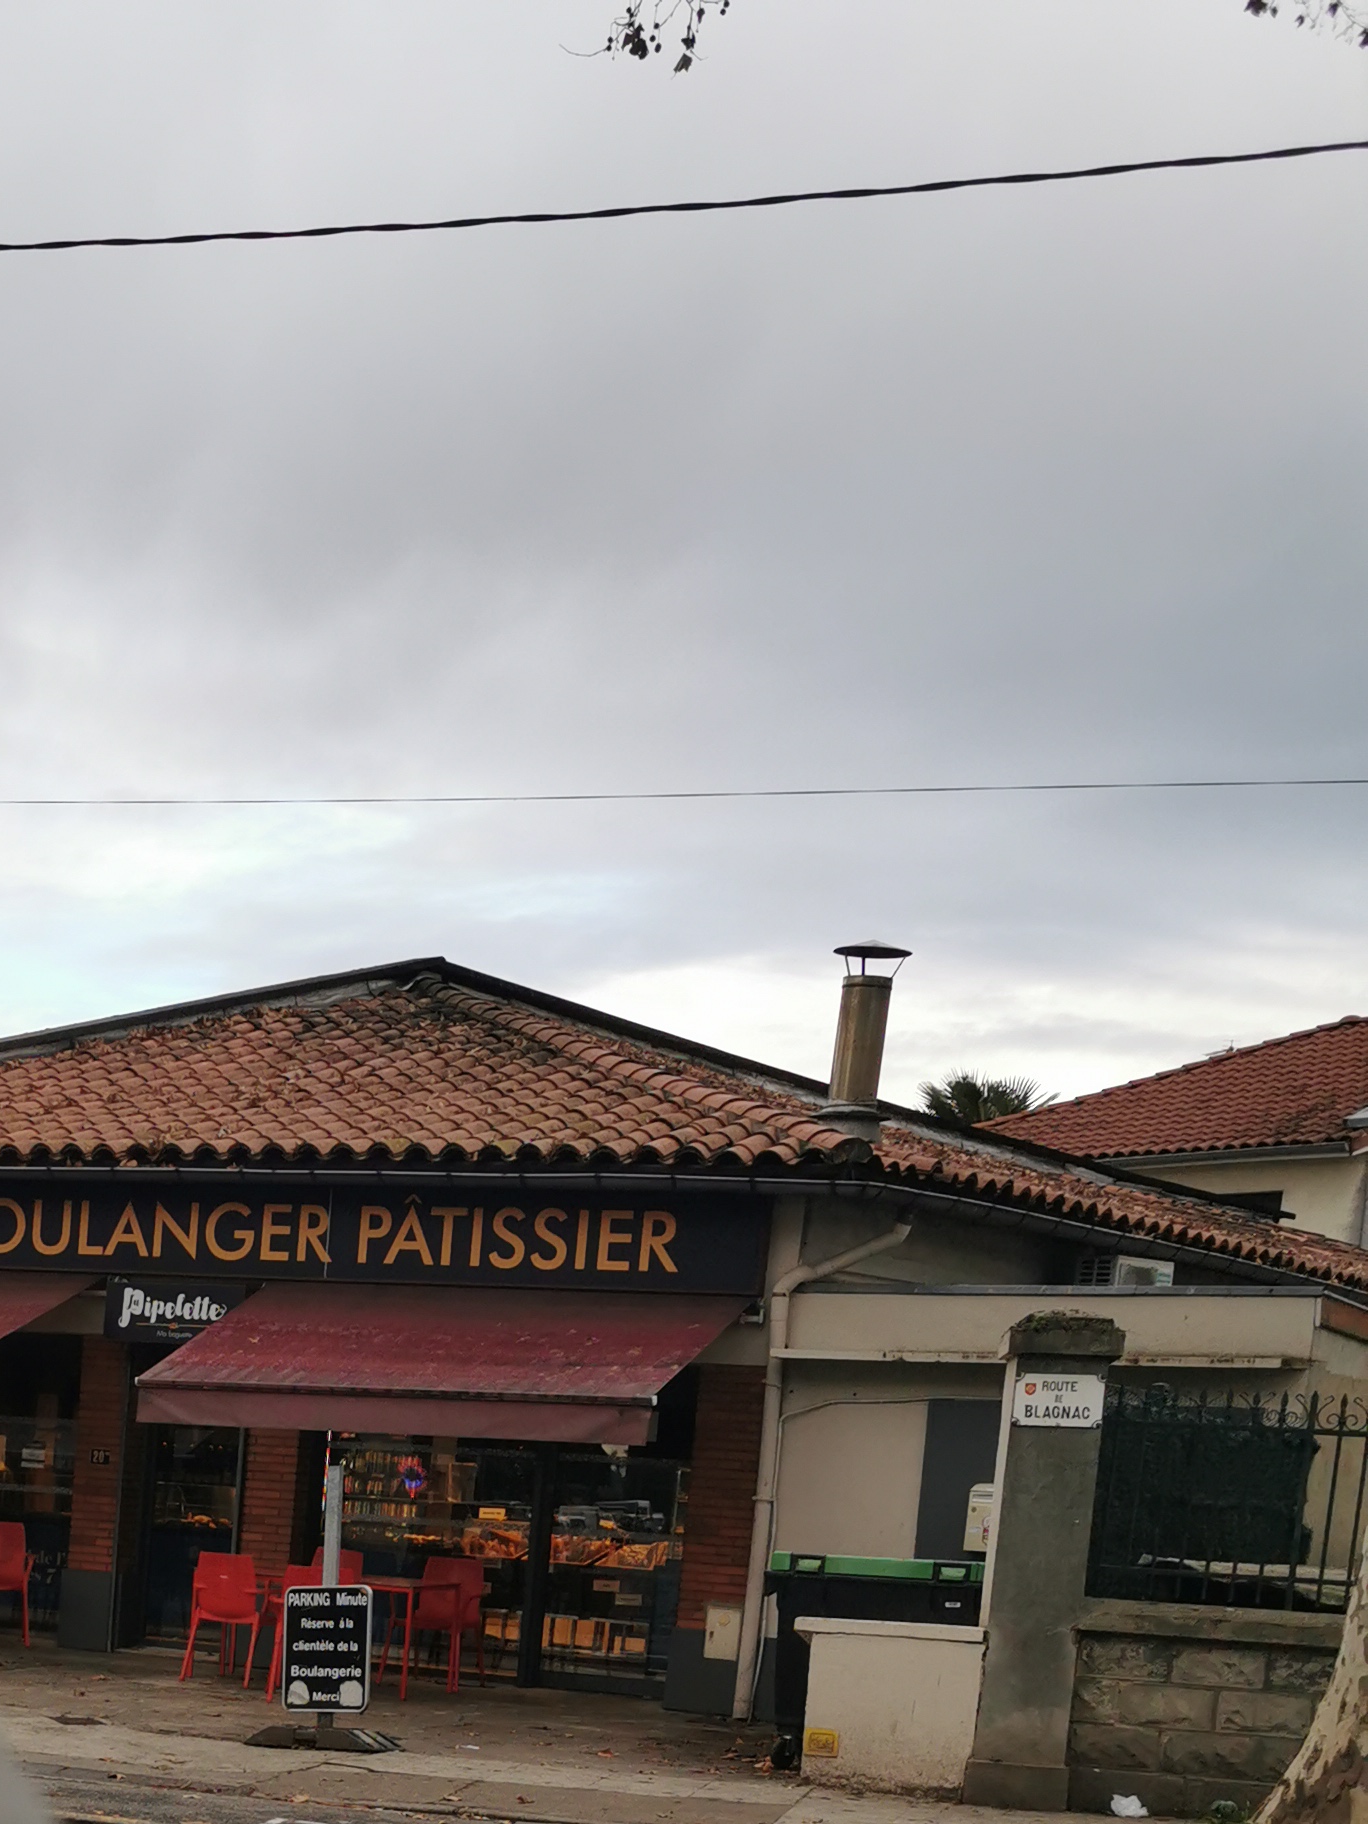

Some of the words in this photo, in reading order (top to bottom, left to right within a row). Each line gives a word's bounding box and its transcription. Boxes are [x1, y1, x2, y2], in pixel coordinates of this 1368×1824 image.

[356, 1193, 679, 1273] PÂTISSIER
[118, 1287, 228, 1328] Pipelette
[1041, 1380, 1079, 1392] ROUTE
[1024, 1404, 1091, 1420] BLAGNAC
[288, 1593, 330, 1606] PARKING
[336, 1593, 367, 1606] Minute
[346, 1618, 354, 1629] la
[337, 1641, 349, 1651] de
[350, 1640, 358, 1651] la
[290, 1665, 362, 1679] Boulangerie
[312, 1691, 339, 1701] Merci
